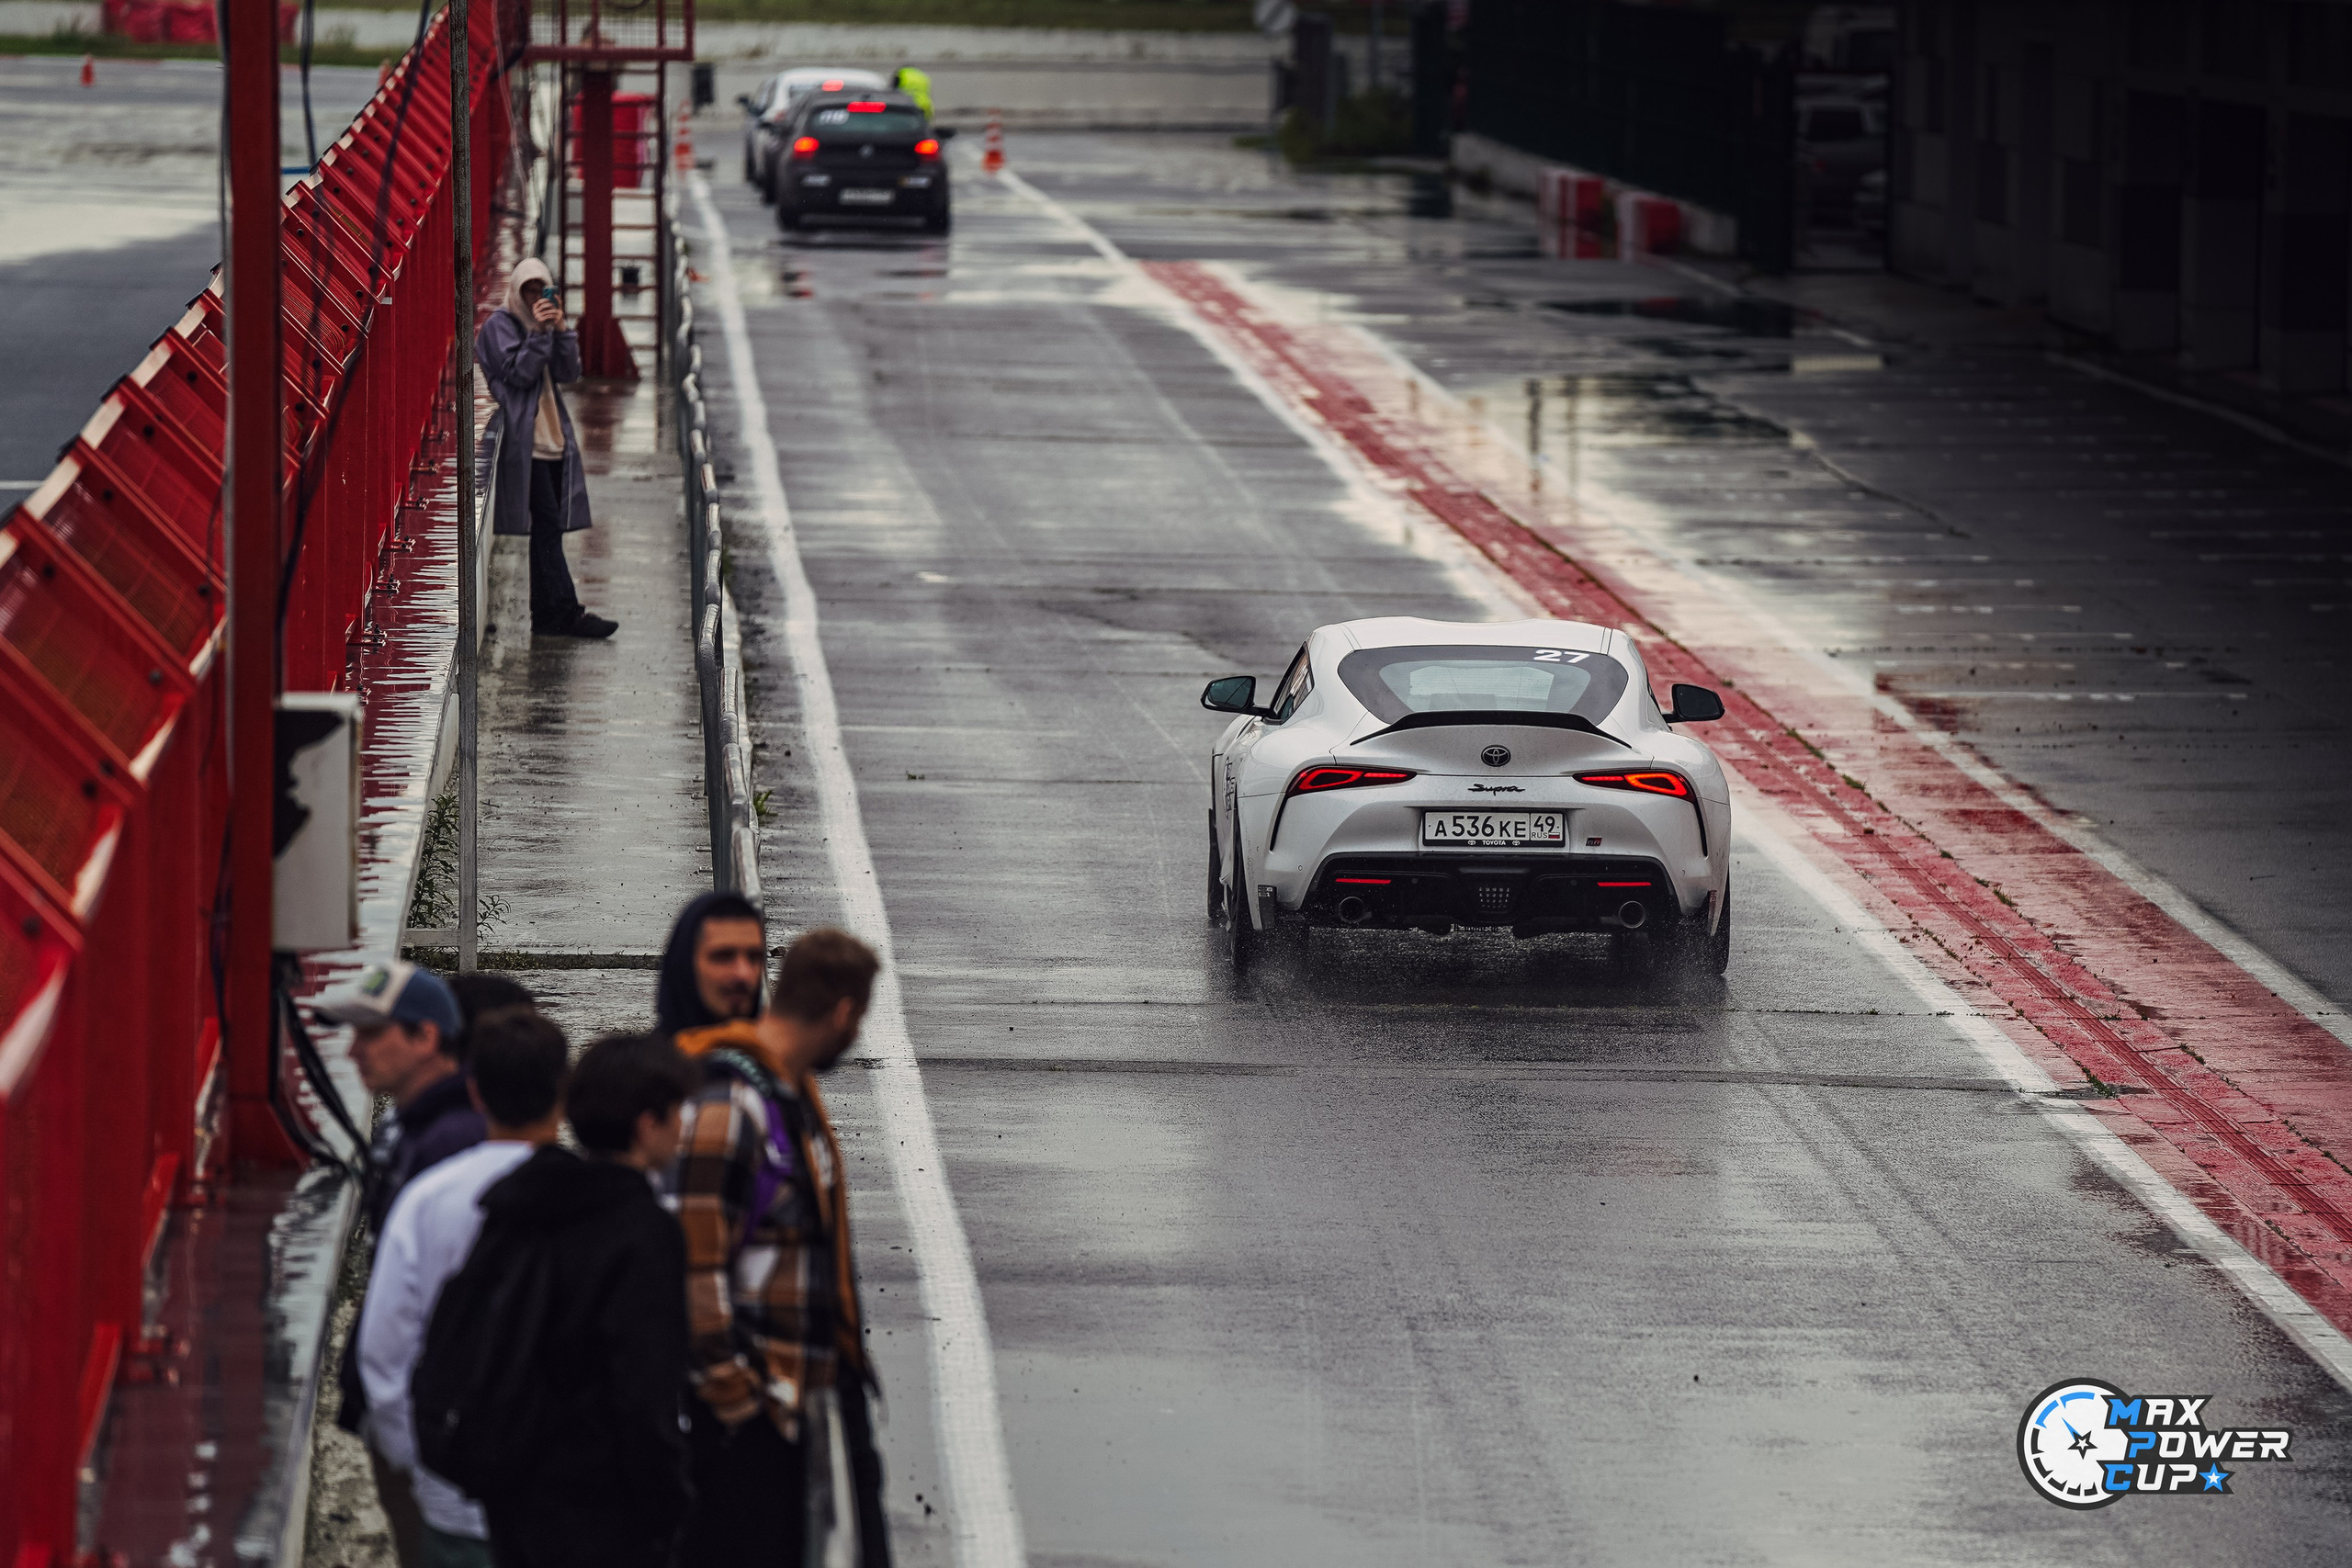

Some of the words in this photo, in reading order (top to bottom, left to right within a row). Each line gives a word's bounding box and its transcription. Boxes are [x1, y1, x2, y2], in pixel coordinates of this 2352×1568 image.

[1532, 649, 1590, 664] 27
[1467, 783, 1526, 796] Supra
[1533, 815, 1555, 833] 49
